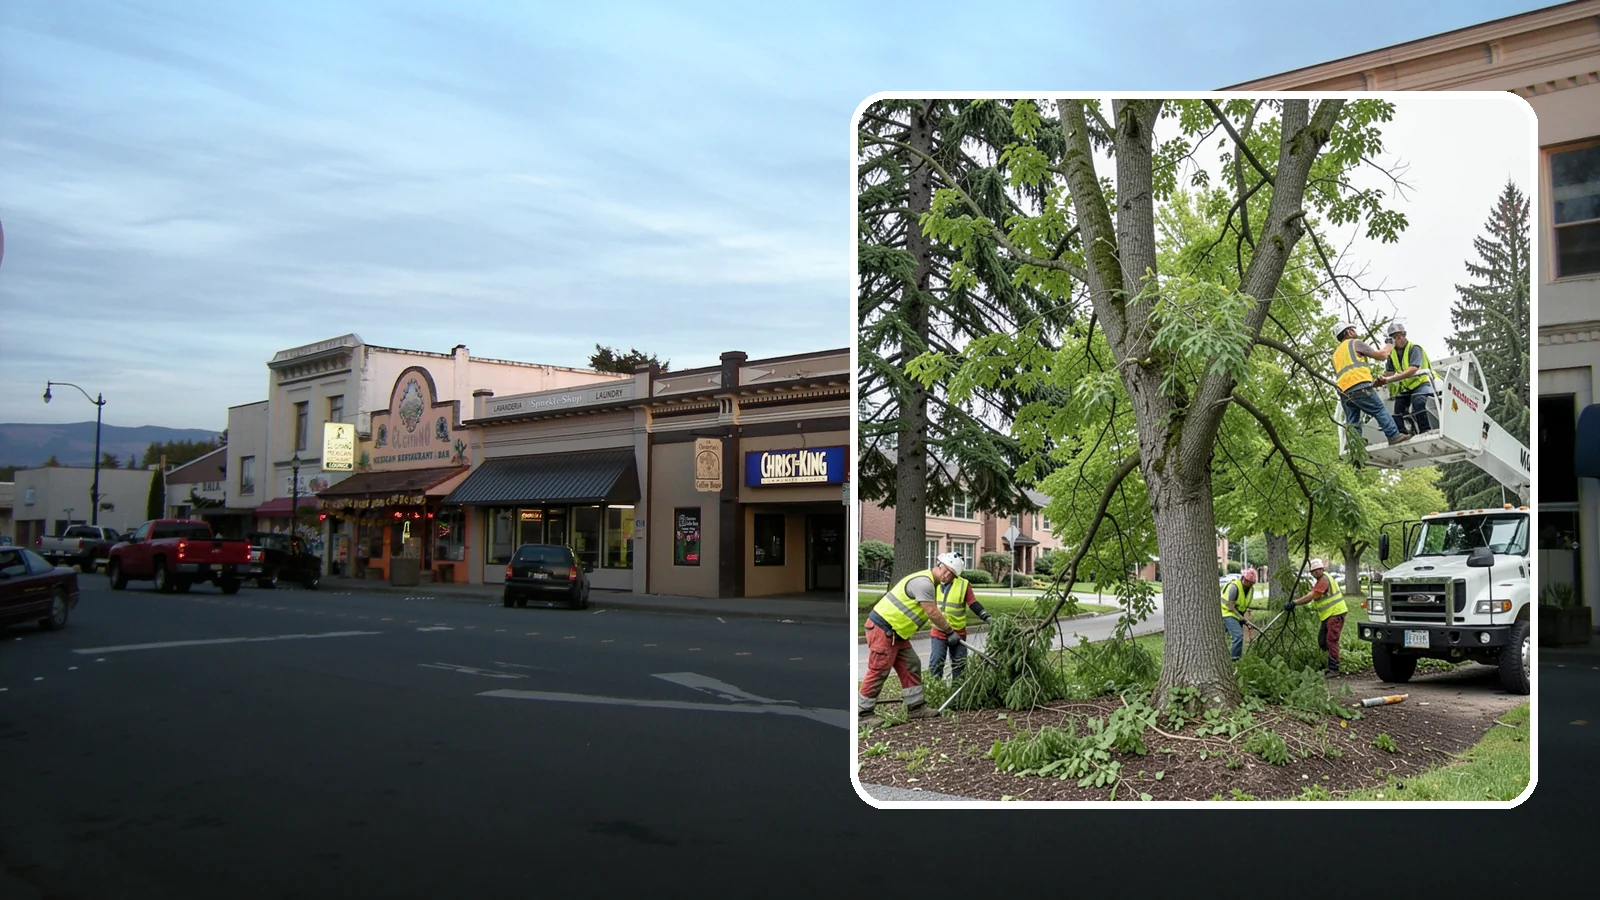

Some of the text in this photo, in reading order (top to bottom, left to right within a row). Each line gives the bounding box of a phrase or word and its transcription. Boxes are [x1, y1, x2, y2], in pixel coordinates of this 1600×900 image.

[530, 394, 583, 409] Sparkle Shop
[595, 389, 623, 400] LAUNDRY
[493, 402, 522, 413] LAVANDERIA
[373, 450, 450, 464] MEXICAN RESTAURANT BAR
[761, 450, 827, 478] CHRIST KING
